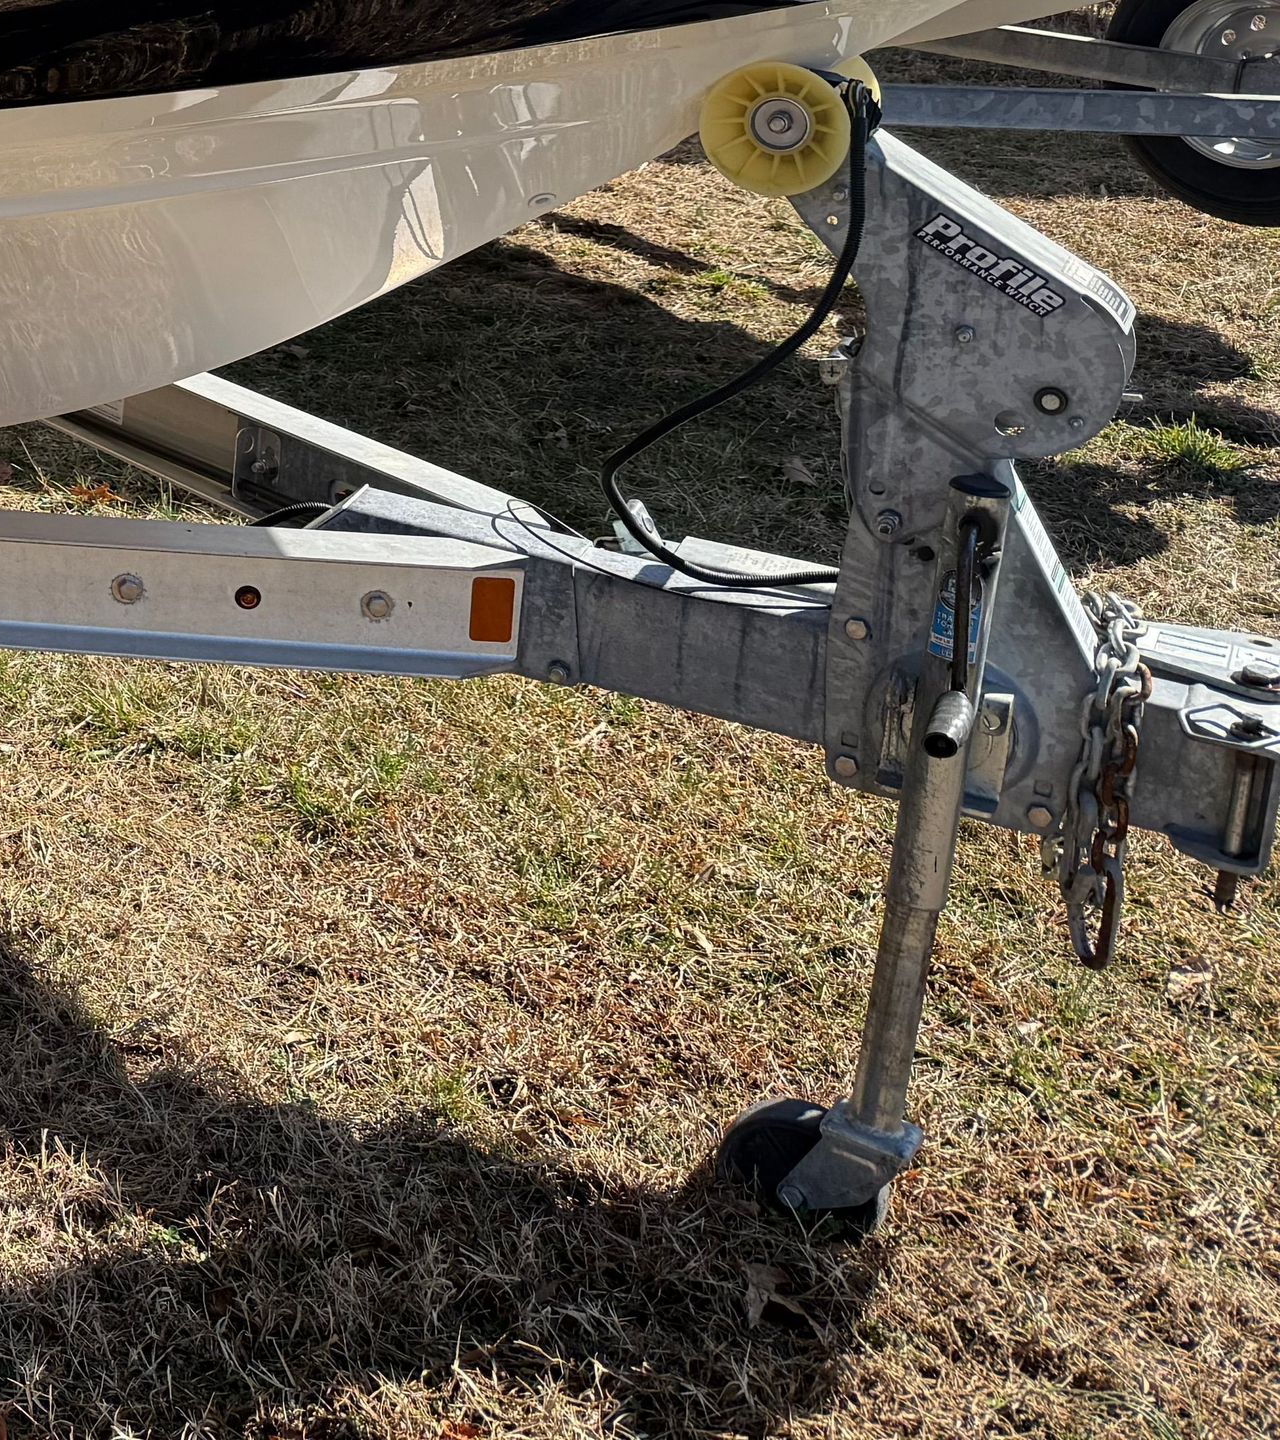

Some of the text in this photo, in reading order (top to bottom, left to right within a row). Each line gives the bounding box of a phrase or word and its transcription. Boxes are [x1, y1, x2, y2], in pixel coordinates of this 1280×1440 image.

[916, 230, 1004, 289] PERFORMANCE
[1004, 285, 1048, 316] WINCH
[922, 215, 1065, 308] Profile
